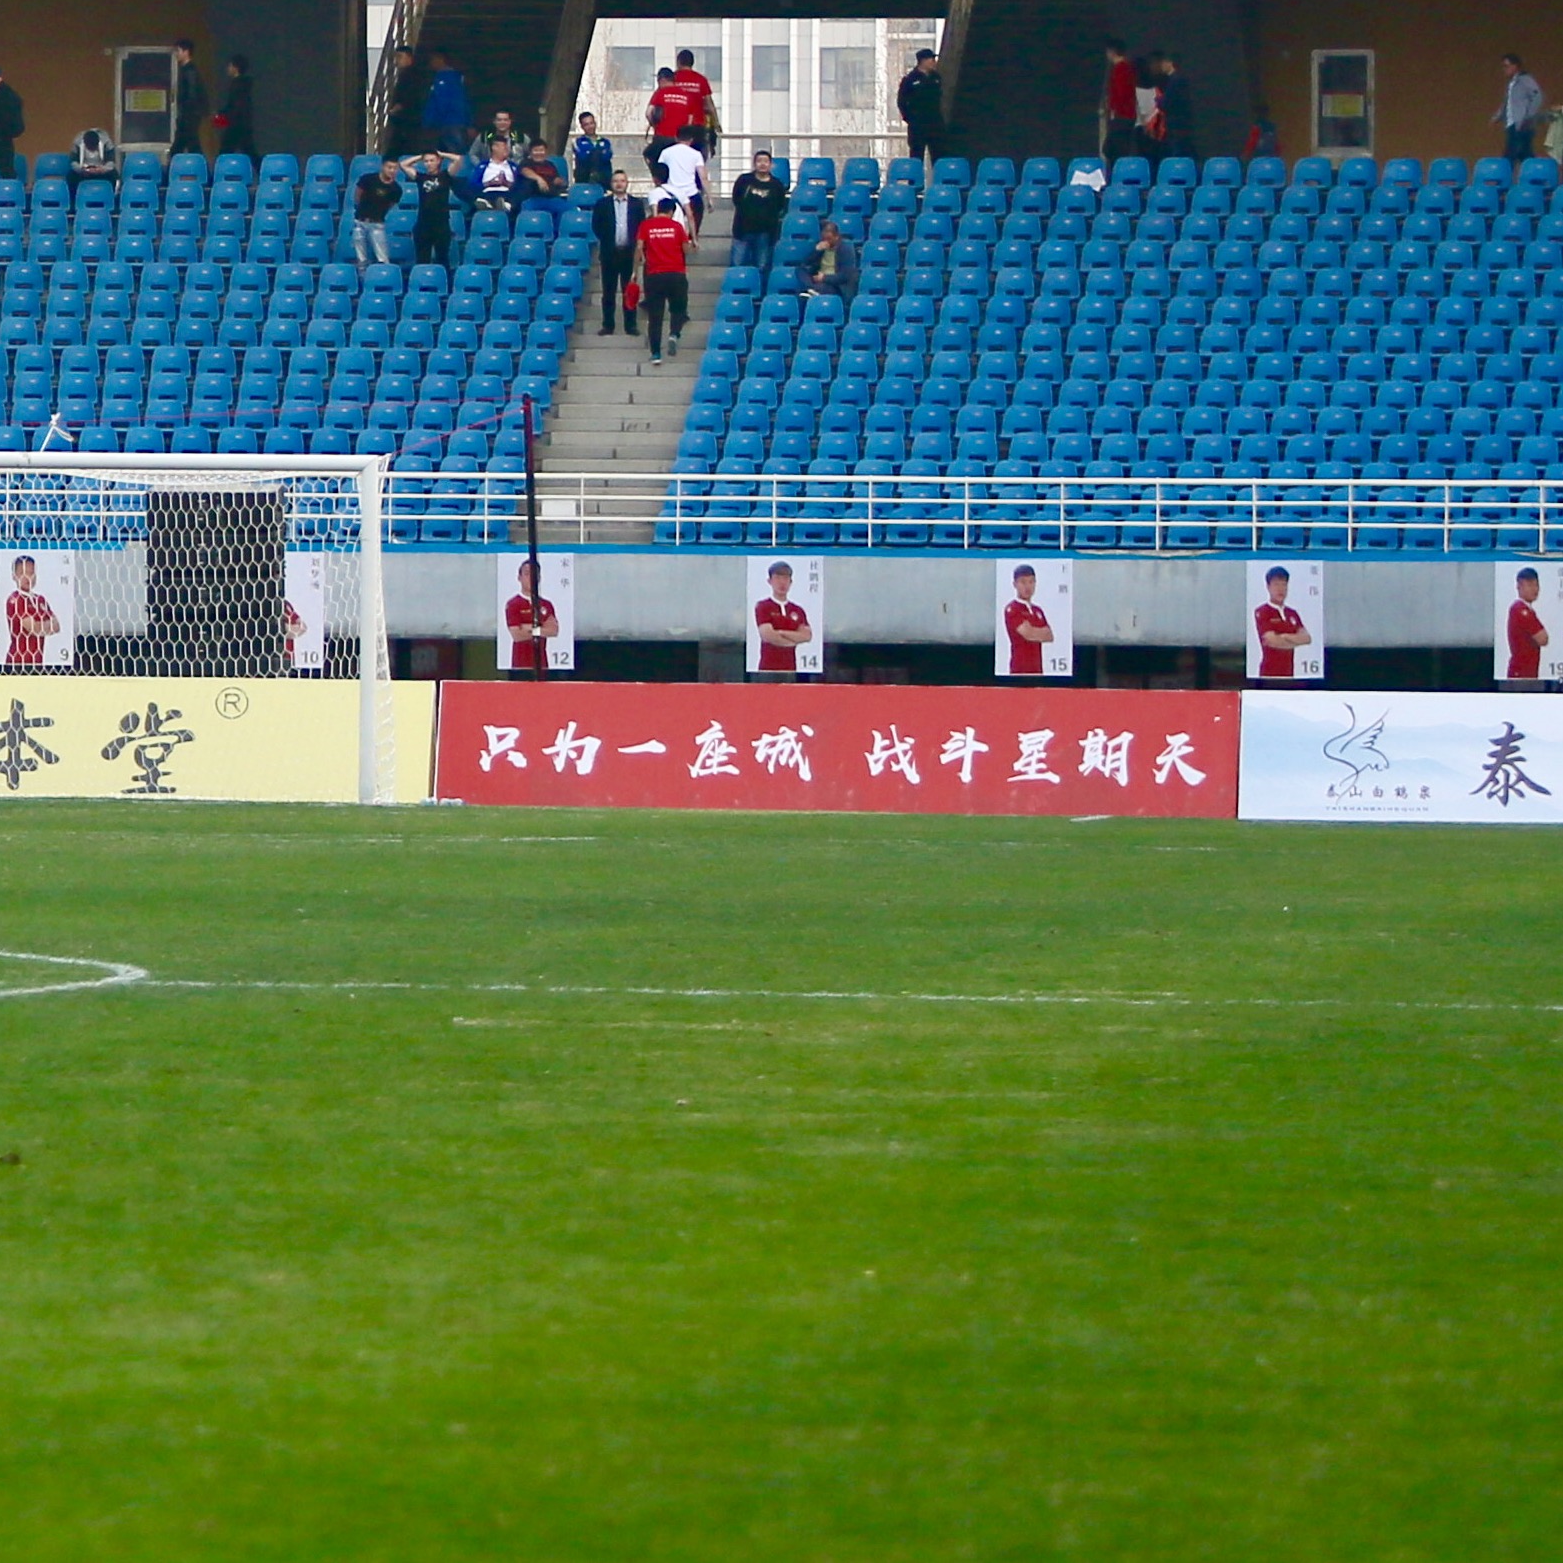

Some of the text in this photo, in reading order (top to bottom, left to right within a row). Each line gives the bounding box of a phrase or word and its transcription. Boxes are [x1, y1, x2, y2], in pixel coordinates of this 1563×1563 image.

[60, 648, 70, 662] 9
[301, 651, 320, 664] 10
[550, 652, 570, 667] 12
[799, 654, 819, 670] 14
[1048, 657, 1069, 673] 15
[1301, 659, 1320, 675] 16
[479, 720, 1207, 787] 只为一座城 战斗星期天
[1468, 721, 1553, 808] 泰
